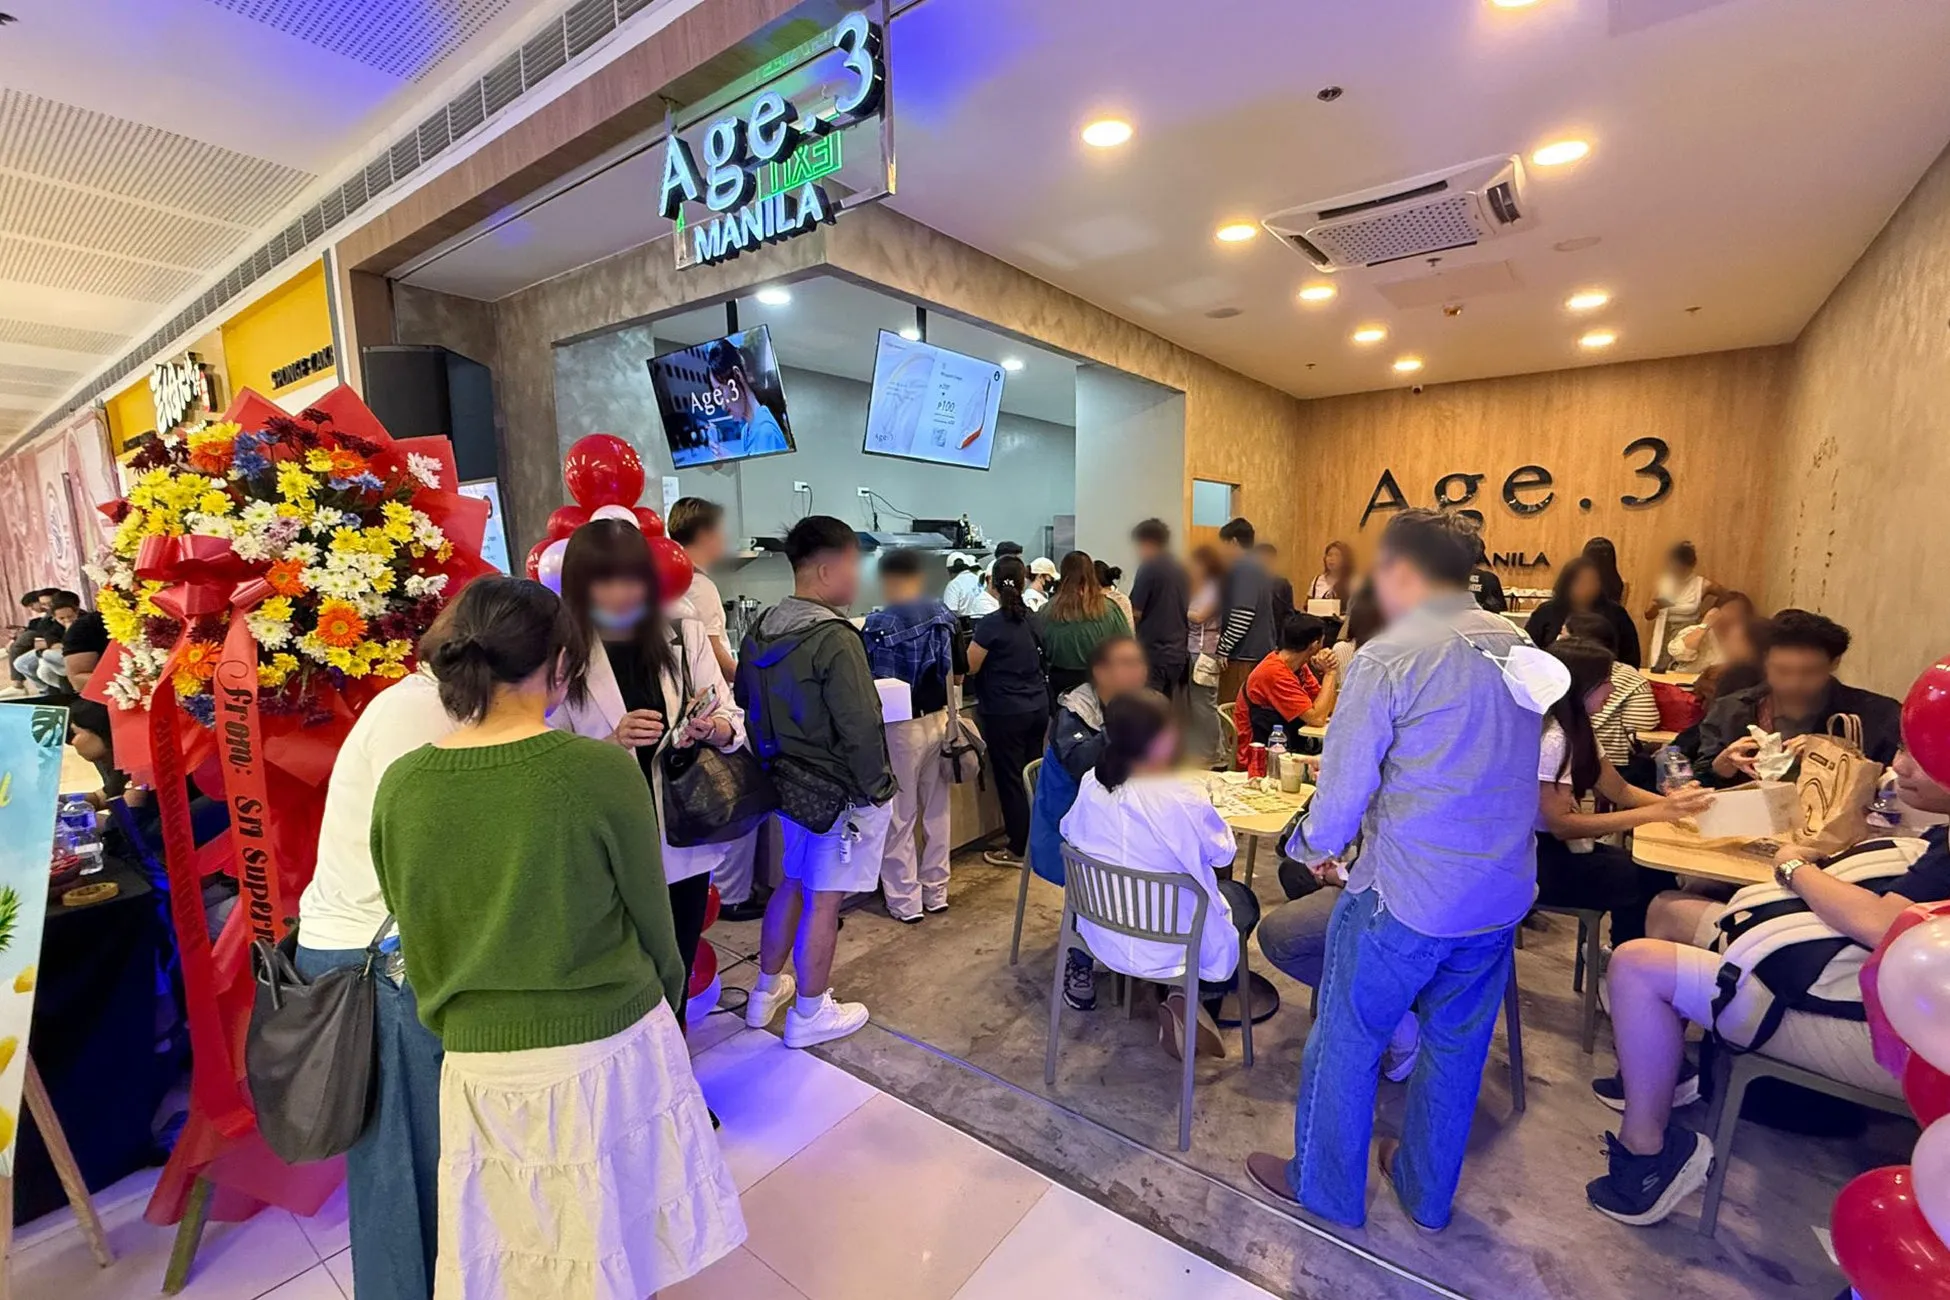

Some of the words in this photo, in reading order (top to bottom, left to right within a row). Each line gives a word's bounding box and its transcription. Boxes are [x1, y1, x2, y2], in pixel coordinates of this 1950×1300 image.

[694, 182, 827, 264] MANILA
[271, 357, 310, 391] SPONGE
[310, 344, 336, 373] CAK
[691, 379, 739, 415] Age.3
[1478, 551, 1551, 567] ANILA
[216, 660, 253, 776] From:
